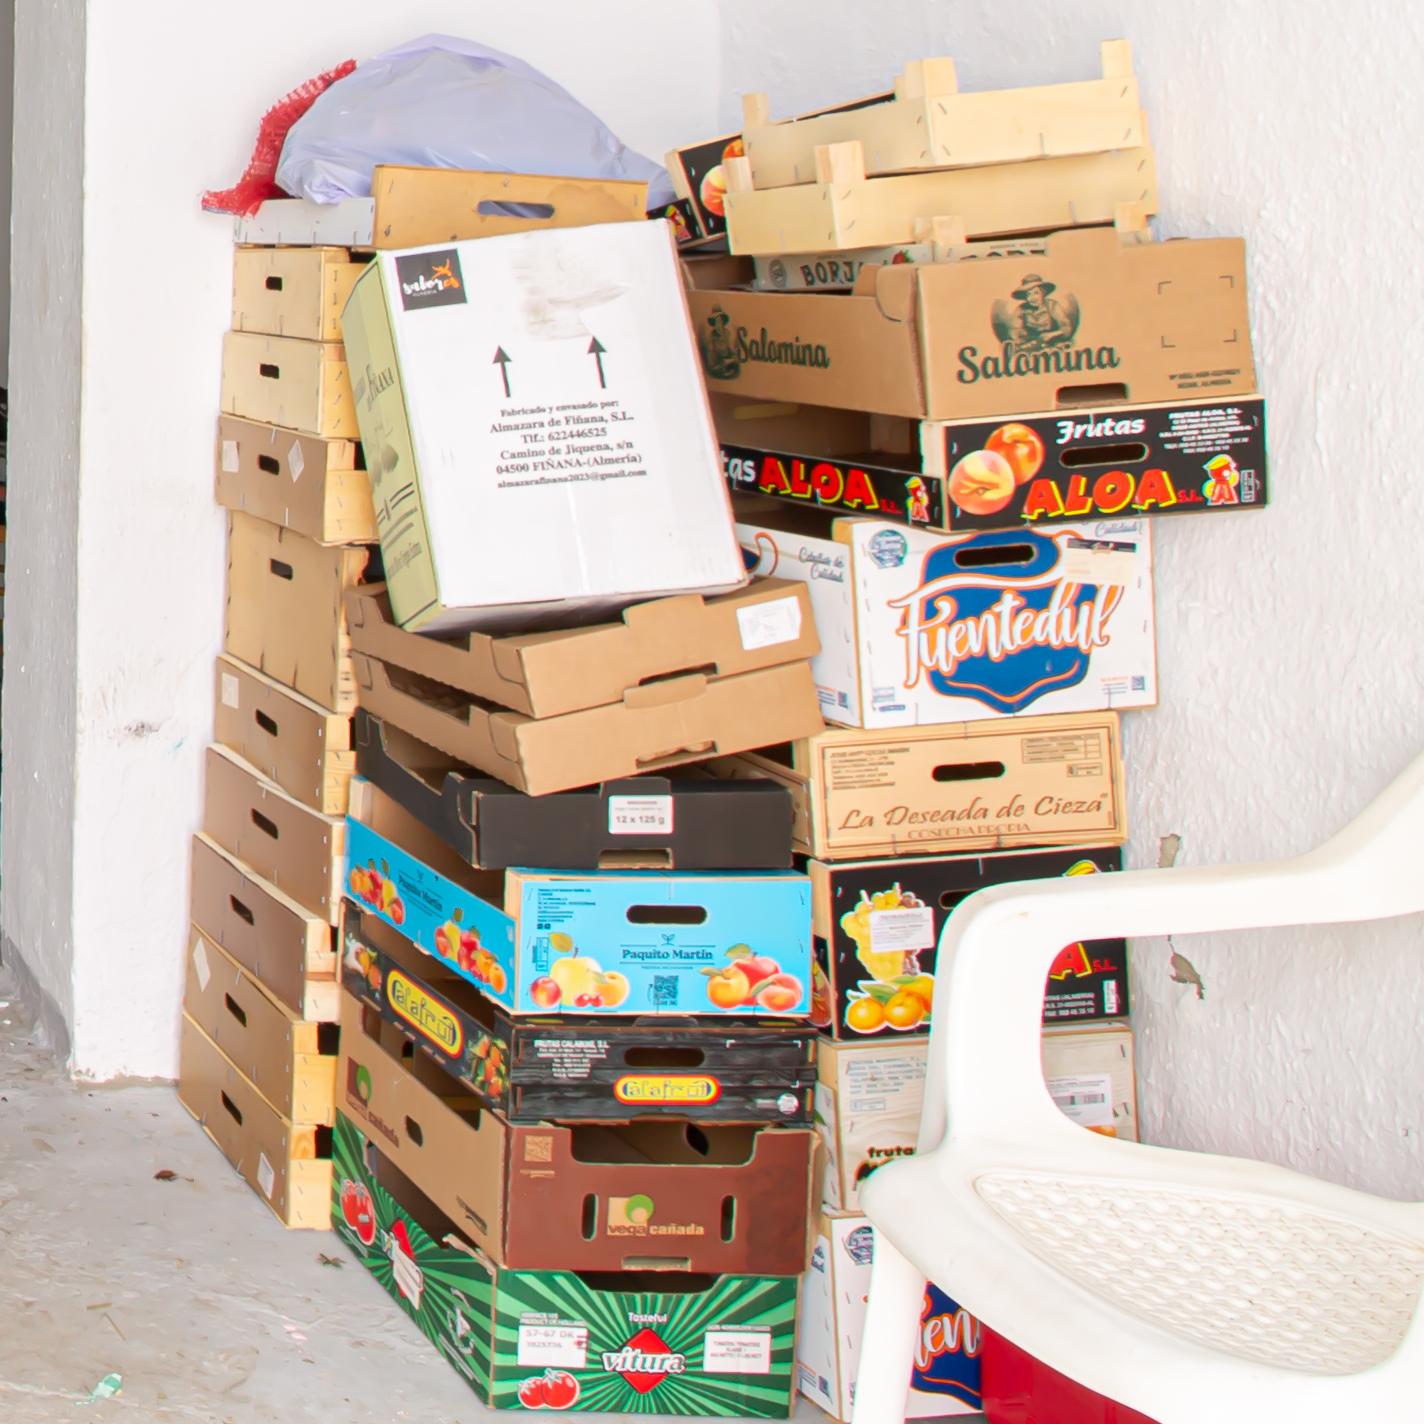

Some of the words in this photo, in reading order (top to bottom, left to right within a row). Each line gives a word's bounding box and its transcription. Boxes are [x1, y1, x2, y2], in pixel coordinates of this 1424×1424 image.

[800, 260, 863, 286] BORJ
[736, 326, 830, 370] Salomina
[956, 341, 1120, 384] Salomina
[500, 406, 546, 417] Fabricado
[555, 401, 599, 412] envasado
[489, 419, 545, 433] Almazara
[548, 417, 562, 428] de
[1056, 417, 1145, 444] Frutas
[500, 447, 546, 460] Camino
[548, 445, 562, 456] de
[616, 439, 634, 450] s/n
[496, 463, 530, 475] 04500
[759, 456, 879, 509] ALOA
[1021, 468, 1177, 520] ALOA
[616, 816, 627, 824] 12
[838, 809, 874, 831] La
[883, 796, 989, 826] Deseada
[995, 794, 1025, 819] de
[1033, 795, 1103, 817] Cieza
[622, 948, 670, 961] Paquito
[649, 1222, 705, 1235] cañada
[602, 1345, 686, 1374] vitura
